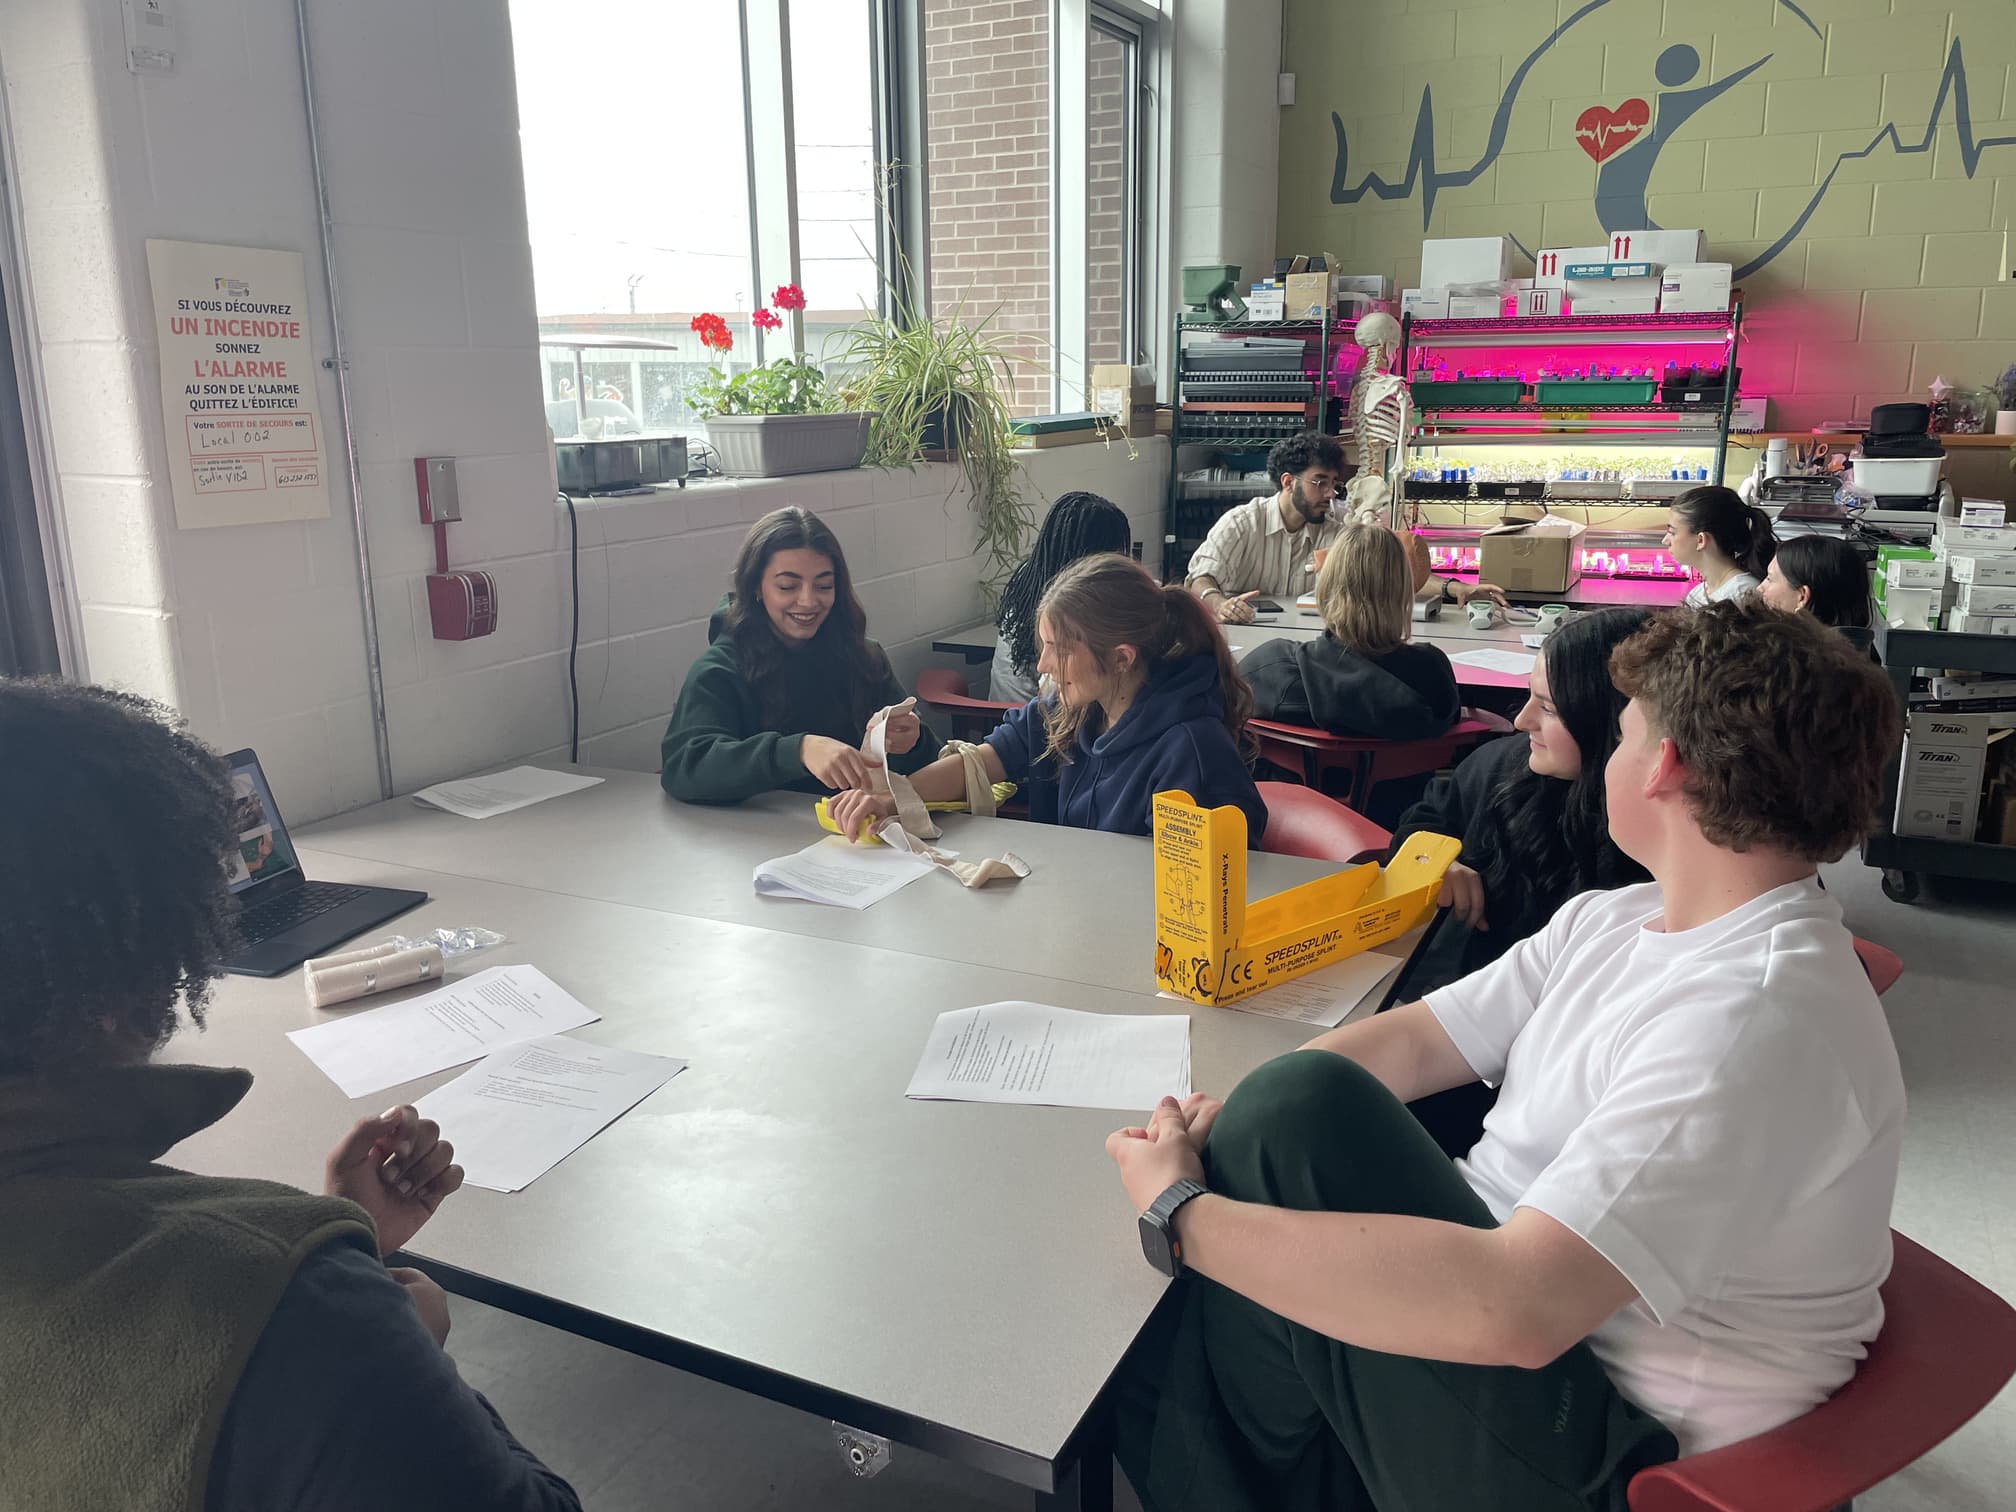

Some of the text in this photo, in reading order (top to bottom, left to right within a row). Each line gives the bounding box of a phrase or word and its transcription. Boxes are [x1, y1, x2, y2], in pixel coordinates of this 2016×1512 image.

[178, 299, 291, 315] SI VOUS DÉCOUVREZ
[170, 317, 301, 339] UN INCENDIE
[215, 343, 261, 354] SONNEZ
[194, 360, 287, 378] L'ALARME
[185, 384, 300, 395] AU SON DE L'ALARME
[189, 396, 298, 412] QUITTEZ L'ÉDIFICE!
[193, 419, 308, 430] Votre SORTIE DE SECOURS est:
[201, 430, 235, 449] Local
[1156, 803, 1204, 822] SPEEDSPLINT
[1165, 822, 1197, 837] ASSEMBLY
[1221, 853, 1229, 887] X-Rays
[1264, 929, 1340, 966] SPEEDSPLINT
[1267, 953, 1315, 974] MULTI-PURPOSE
[1316, 944, 1337, 956] SPLINT
